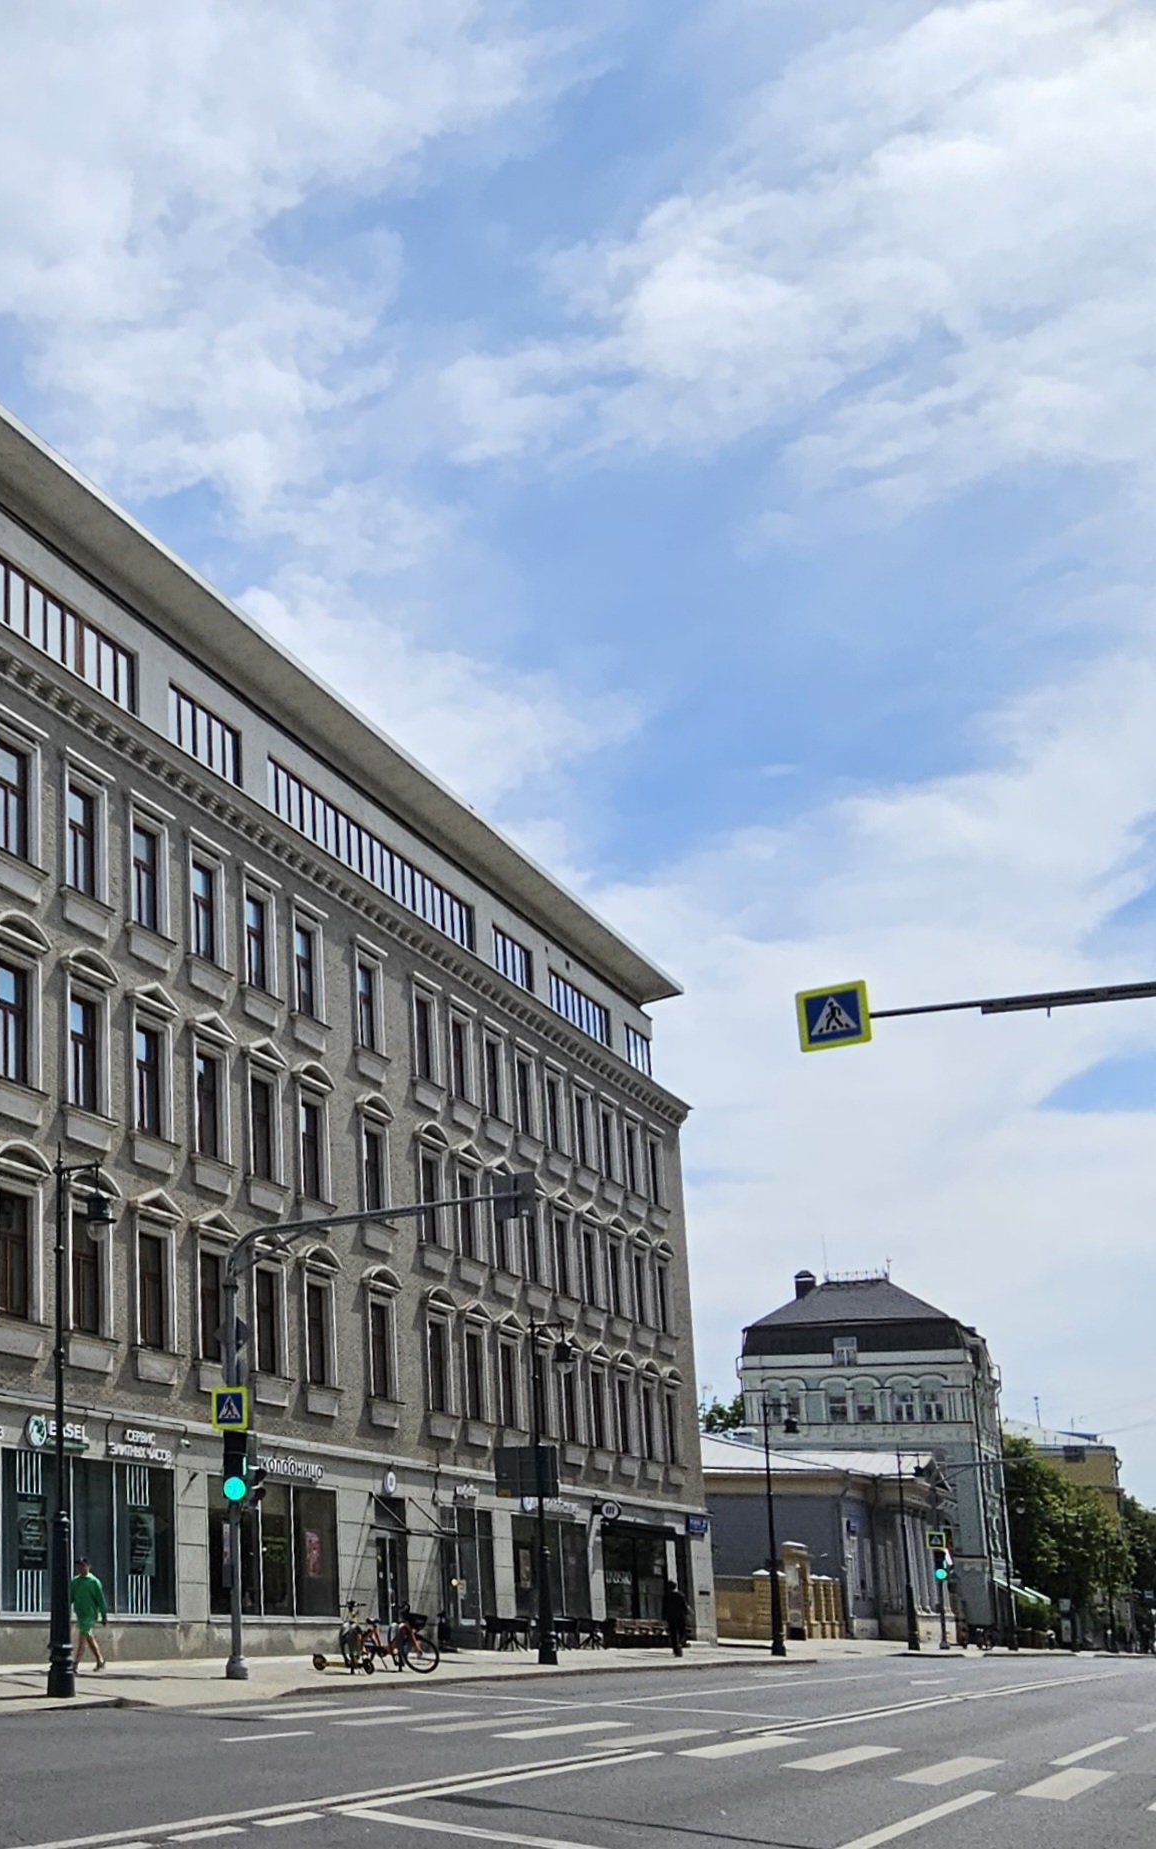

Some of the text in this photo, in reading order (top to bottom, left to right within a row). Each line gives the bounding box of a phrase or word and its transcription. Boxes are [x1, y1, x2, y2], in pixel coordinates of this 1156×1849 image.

[49, 1420, 89, 1444] BSEL
[126, 1429, 156, 1445] СЕРВИС
[108, 1442, 147, 1459] ЭЛИТНЫХ
[147, 1446, 173, 1462] ЧАСОВ
